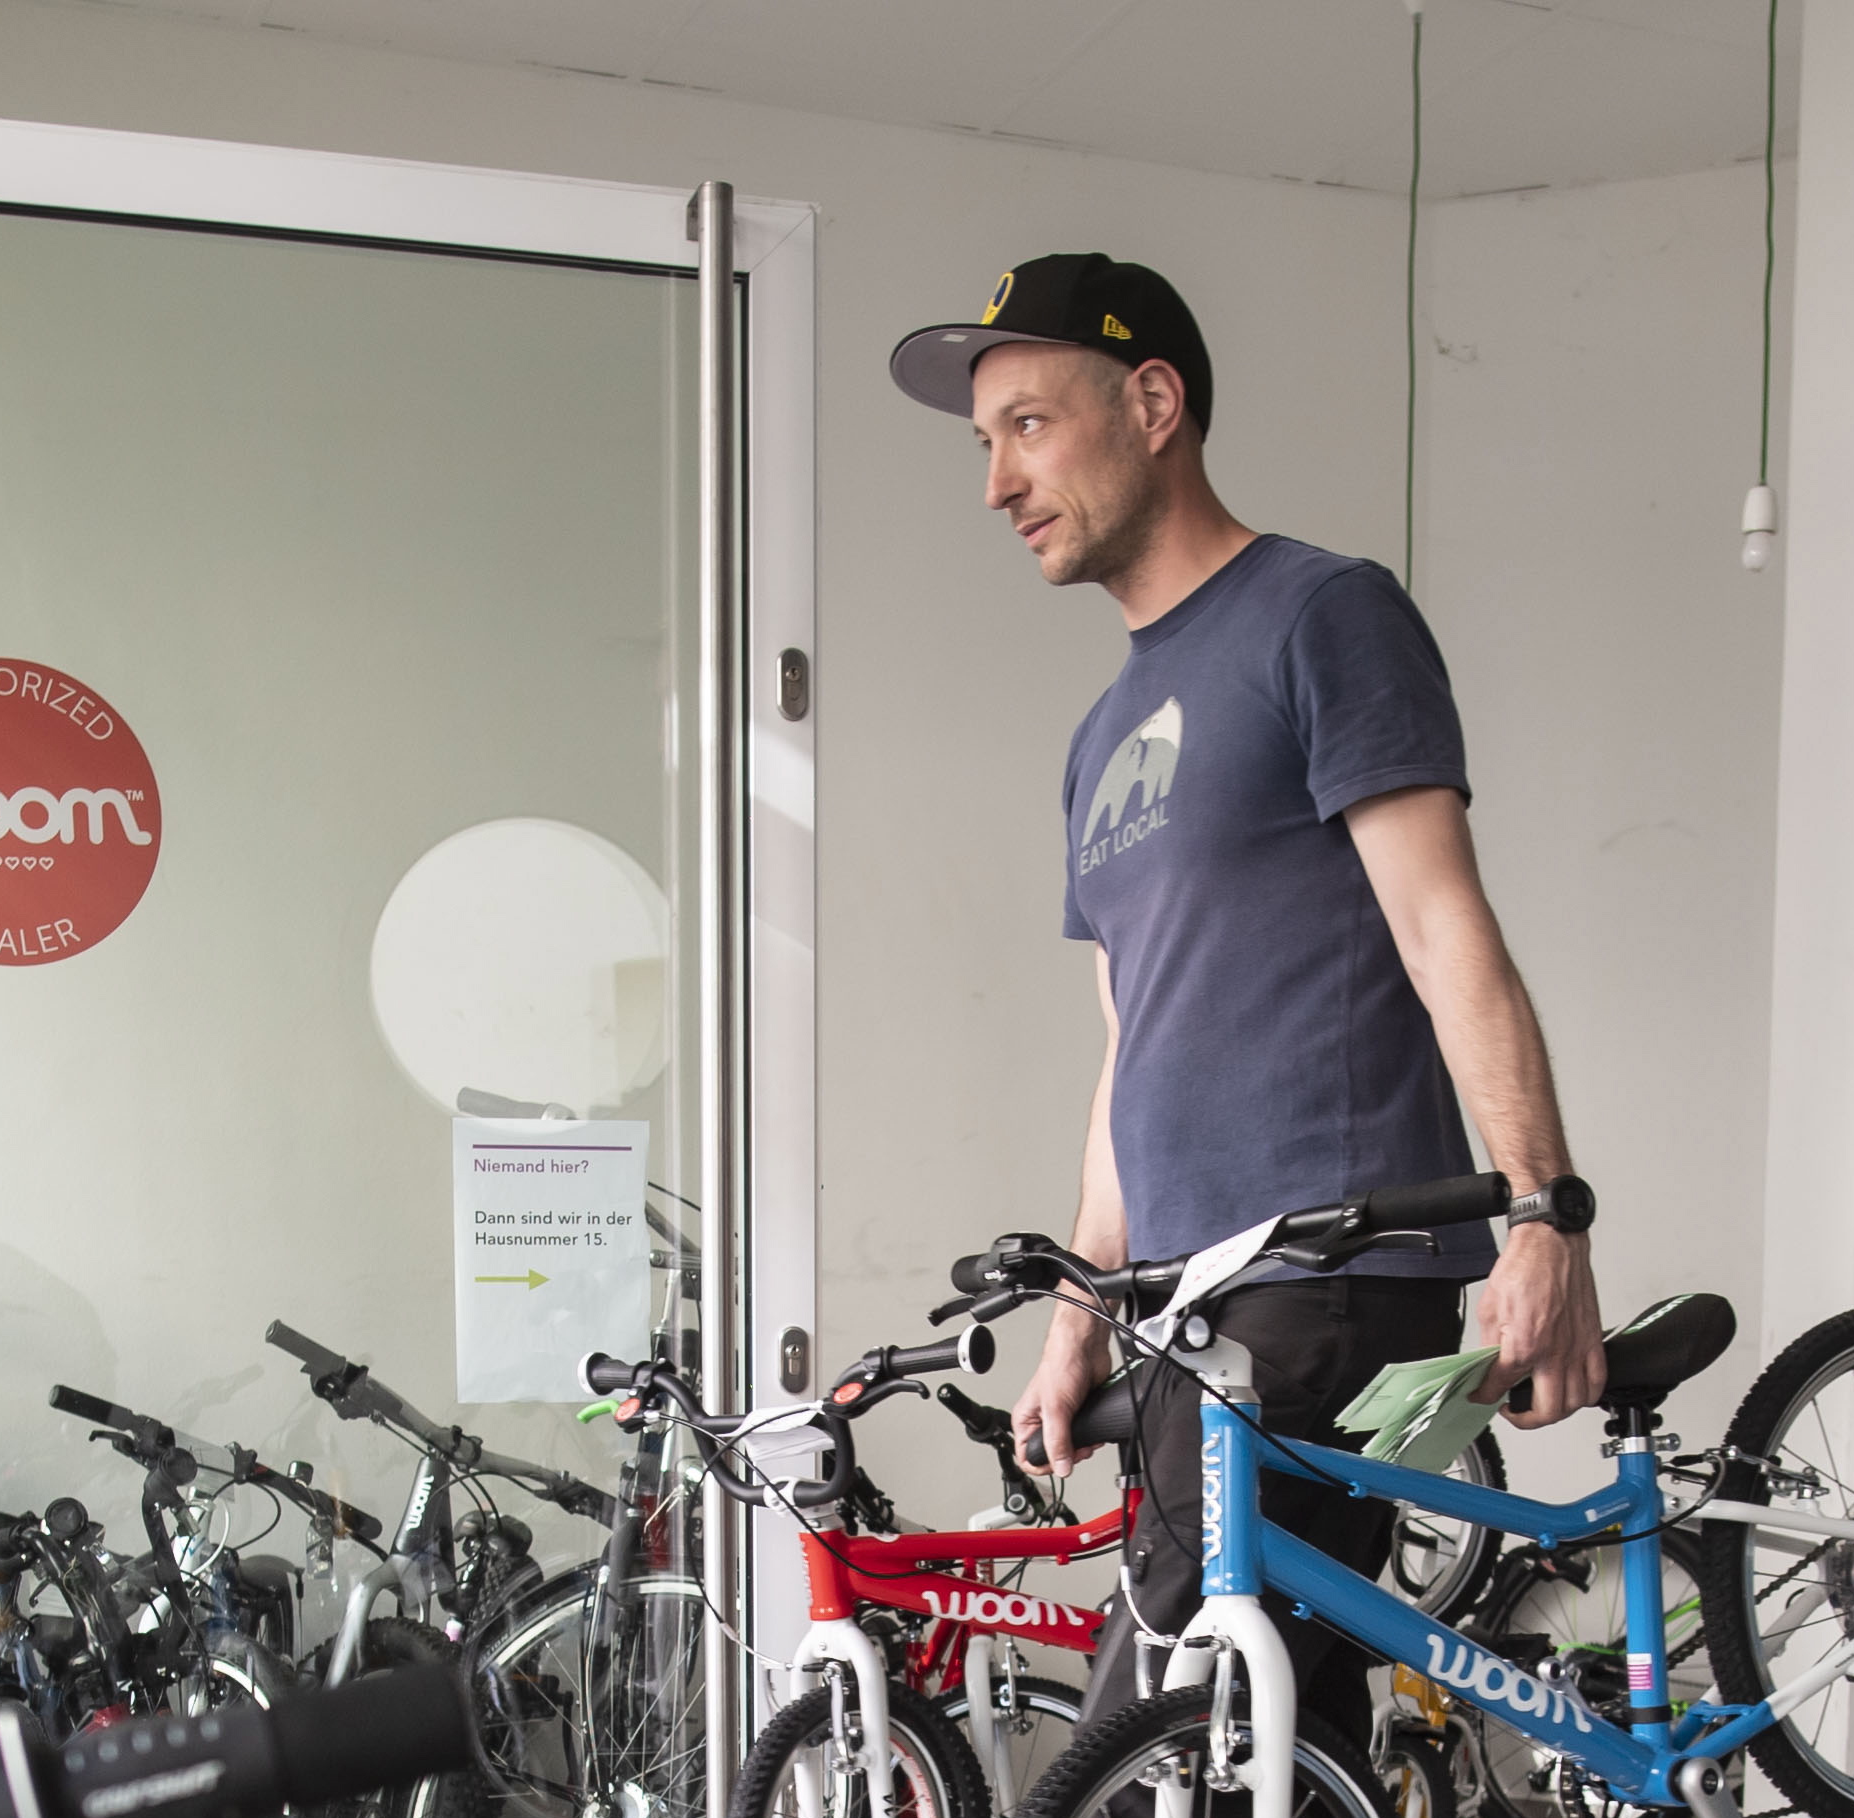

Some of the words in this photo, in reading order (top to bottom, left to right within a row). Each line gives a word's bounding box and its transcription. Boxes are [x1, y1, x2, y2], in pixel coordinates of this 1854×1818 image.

[1079, 836, 1111, 877] EAT
[1113, 803, 1170, 856] LOCAL
[473, 1158, 545, 1173] Niemand
[550, 1159, 589, 1174] hier?
[475, 1211, 515, 1225] Dann
[521, 1210, 553, 1225] sind
[558, 1212, 582, 1226] wir
[587, 1212, 600, 1226] in
[606, 1210, 633, 1226] der
[475, 1232, 578, 1247] Hausnummer
[584, 1232, 608, 1247] 15.
[922, 1590, 1085, 1627] woom
[1427, 1633, 1593, 1733] woom
